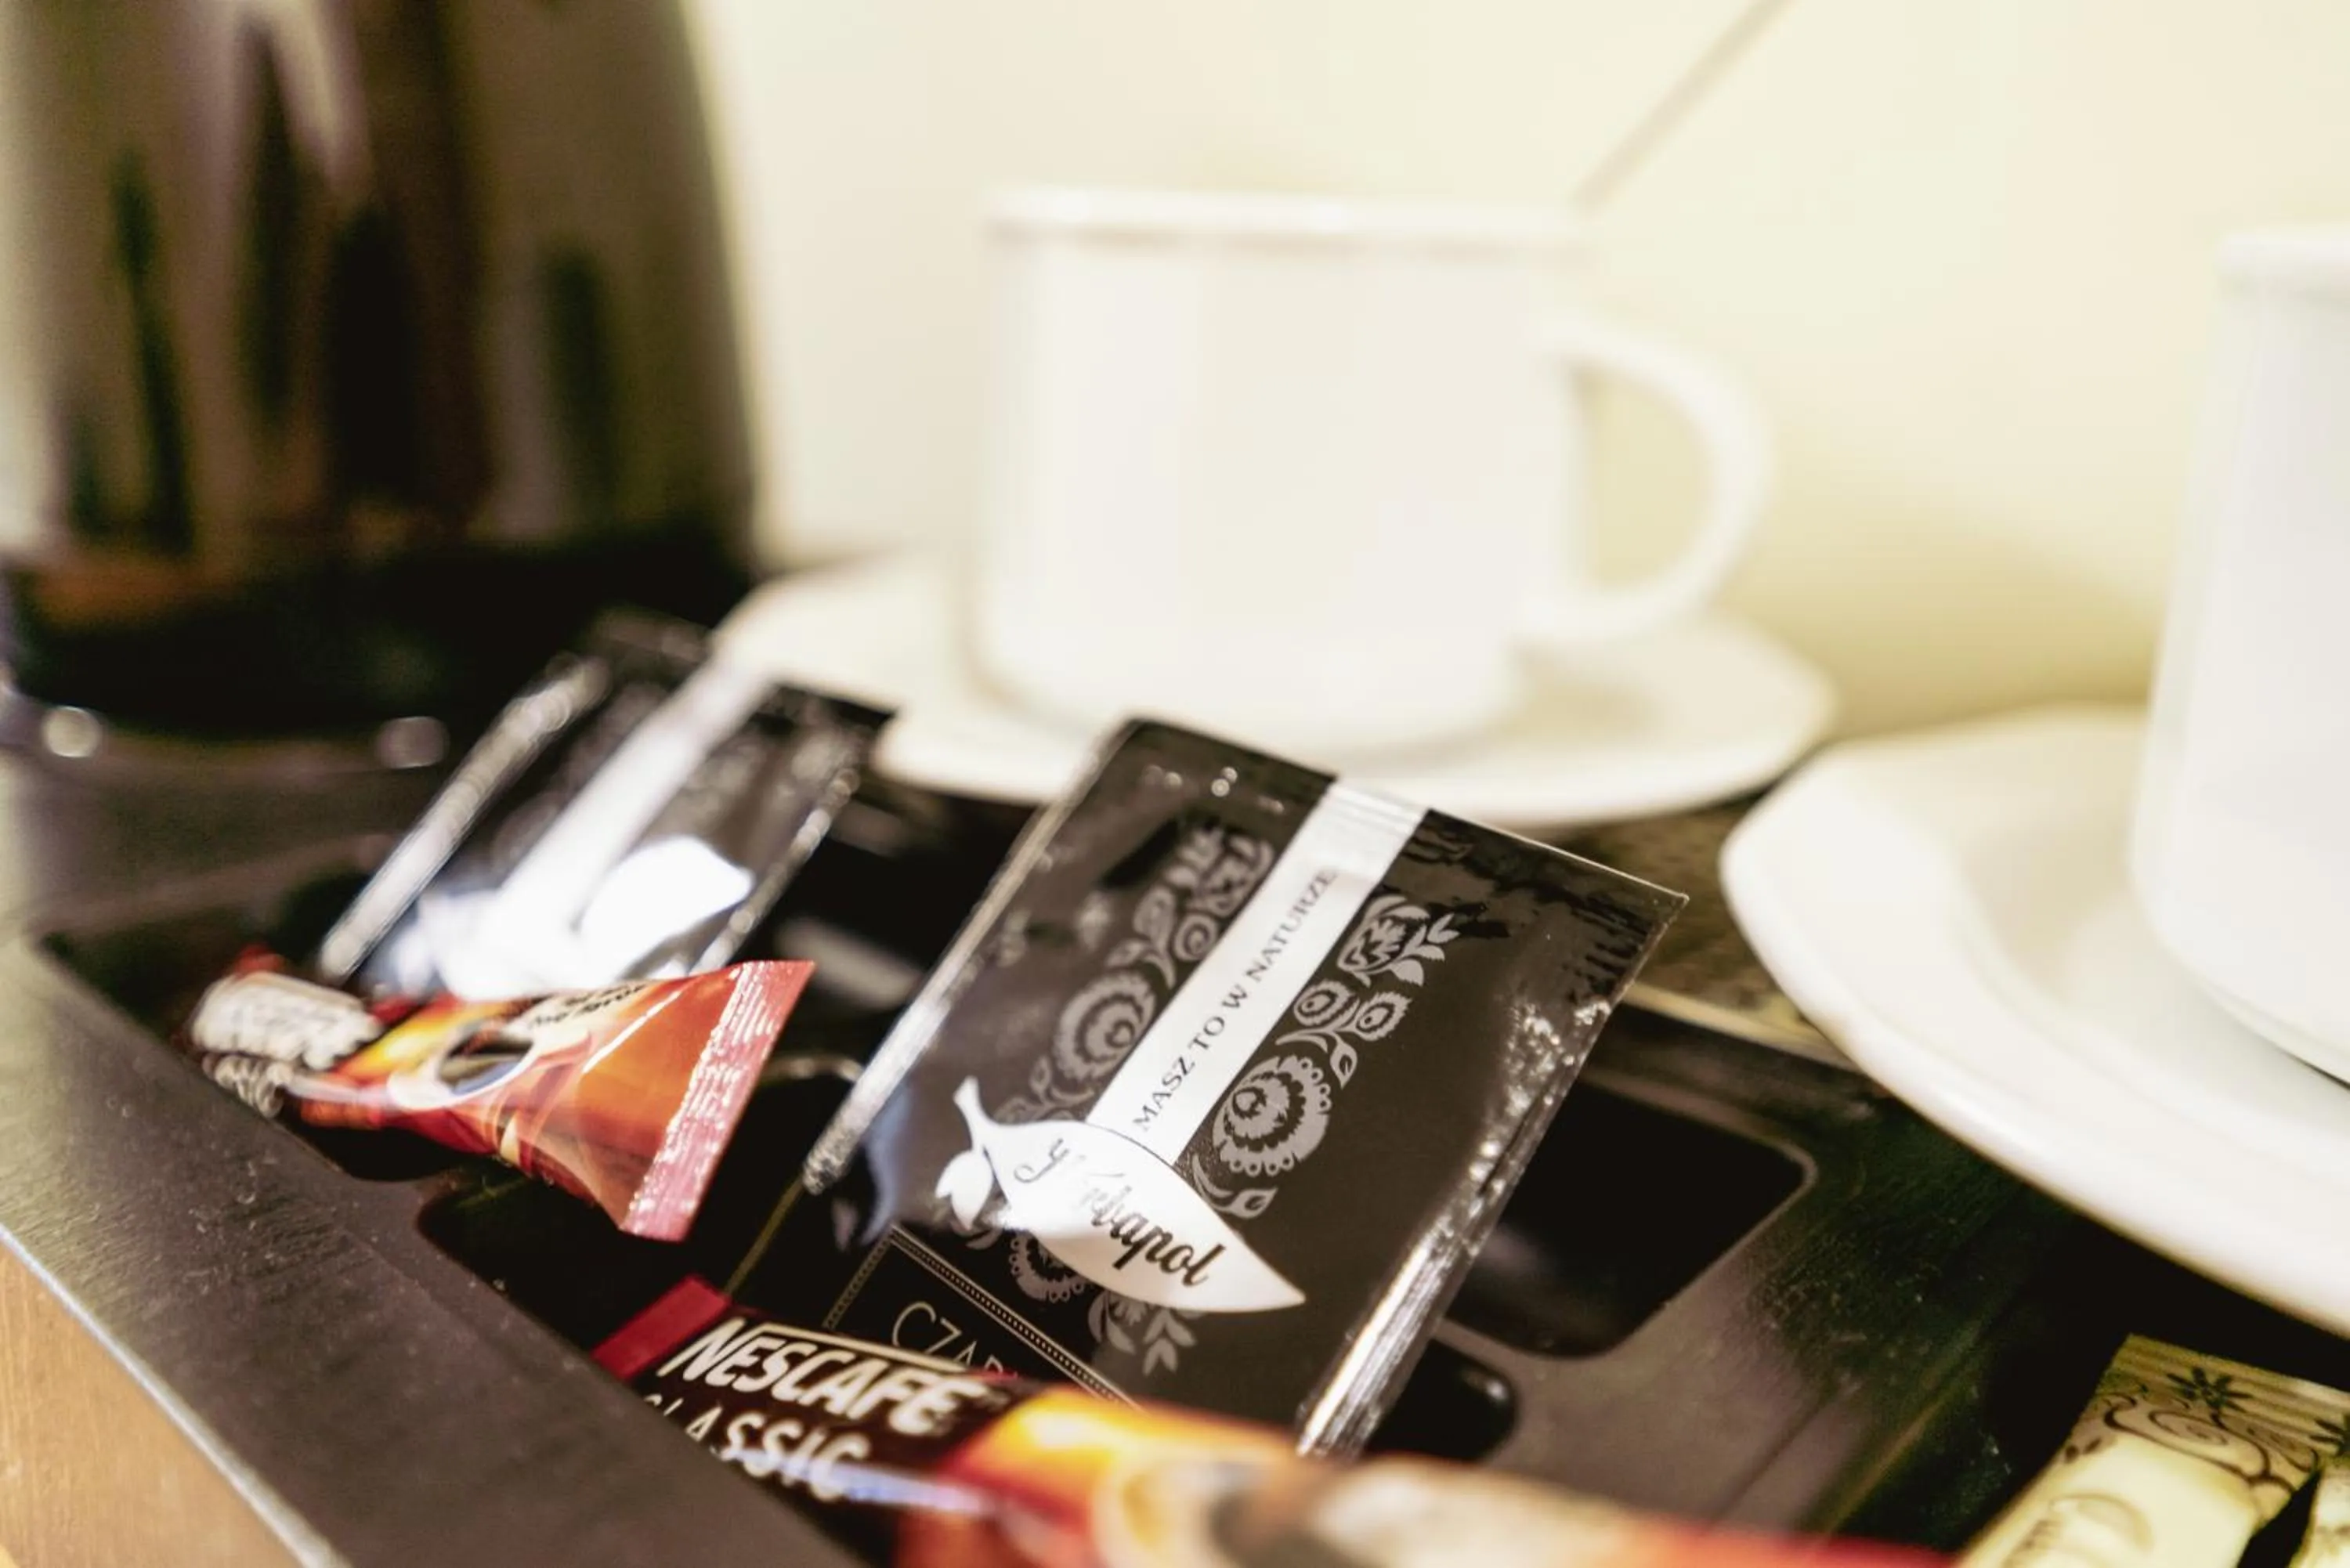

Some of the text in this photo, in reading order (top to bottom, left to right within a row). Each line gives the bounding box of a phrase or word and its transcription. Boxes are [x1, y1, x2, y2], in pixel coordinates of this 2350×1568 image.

[1132, 870, 1336, 1132] MASZ TO W NATURZE
